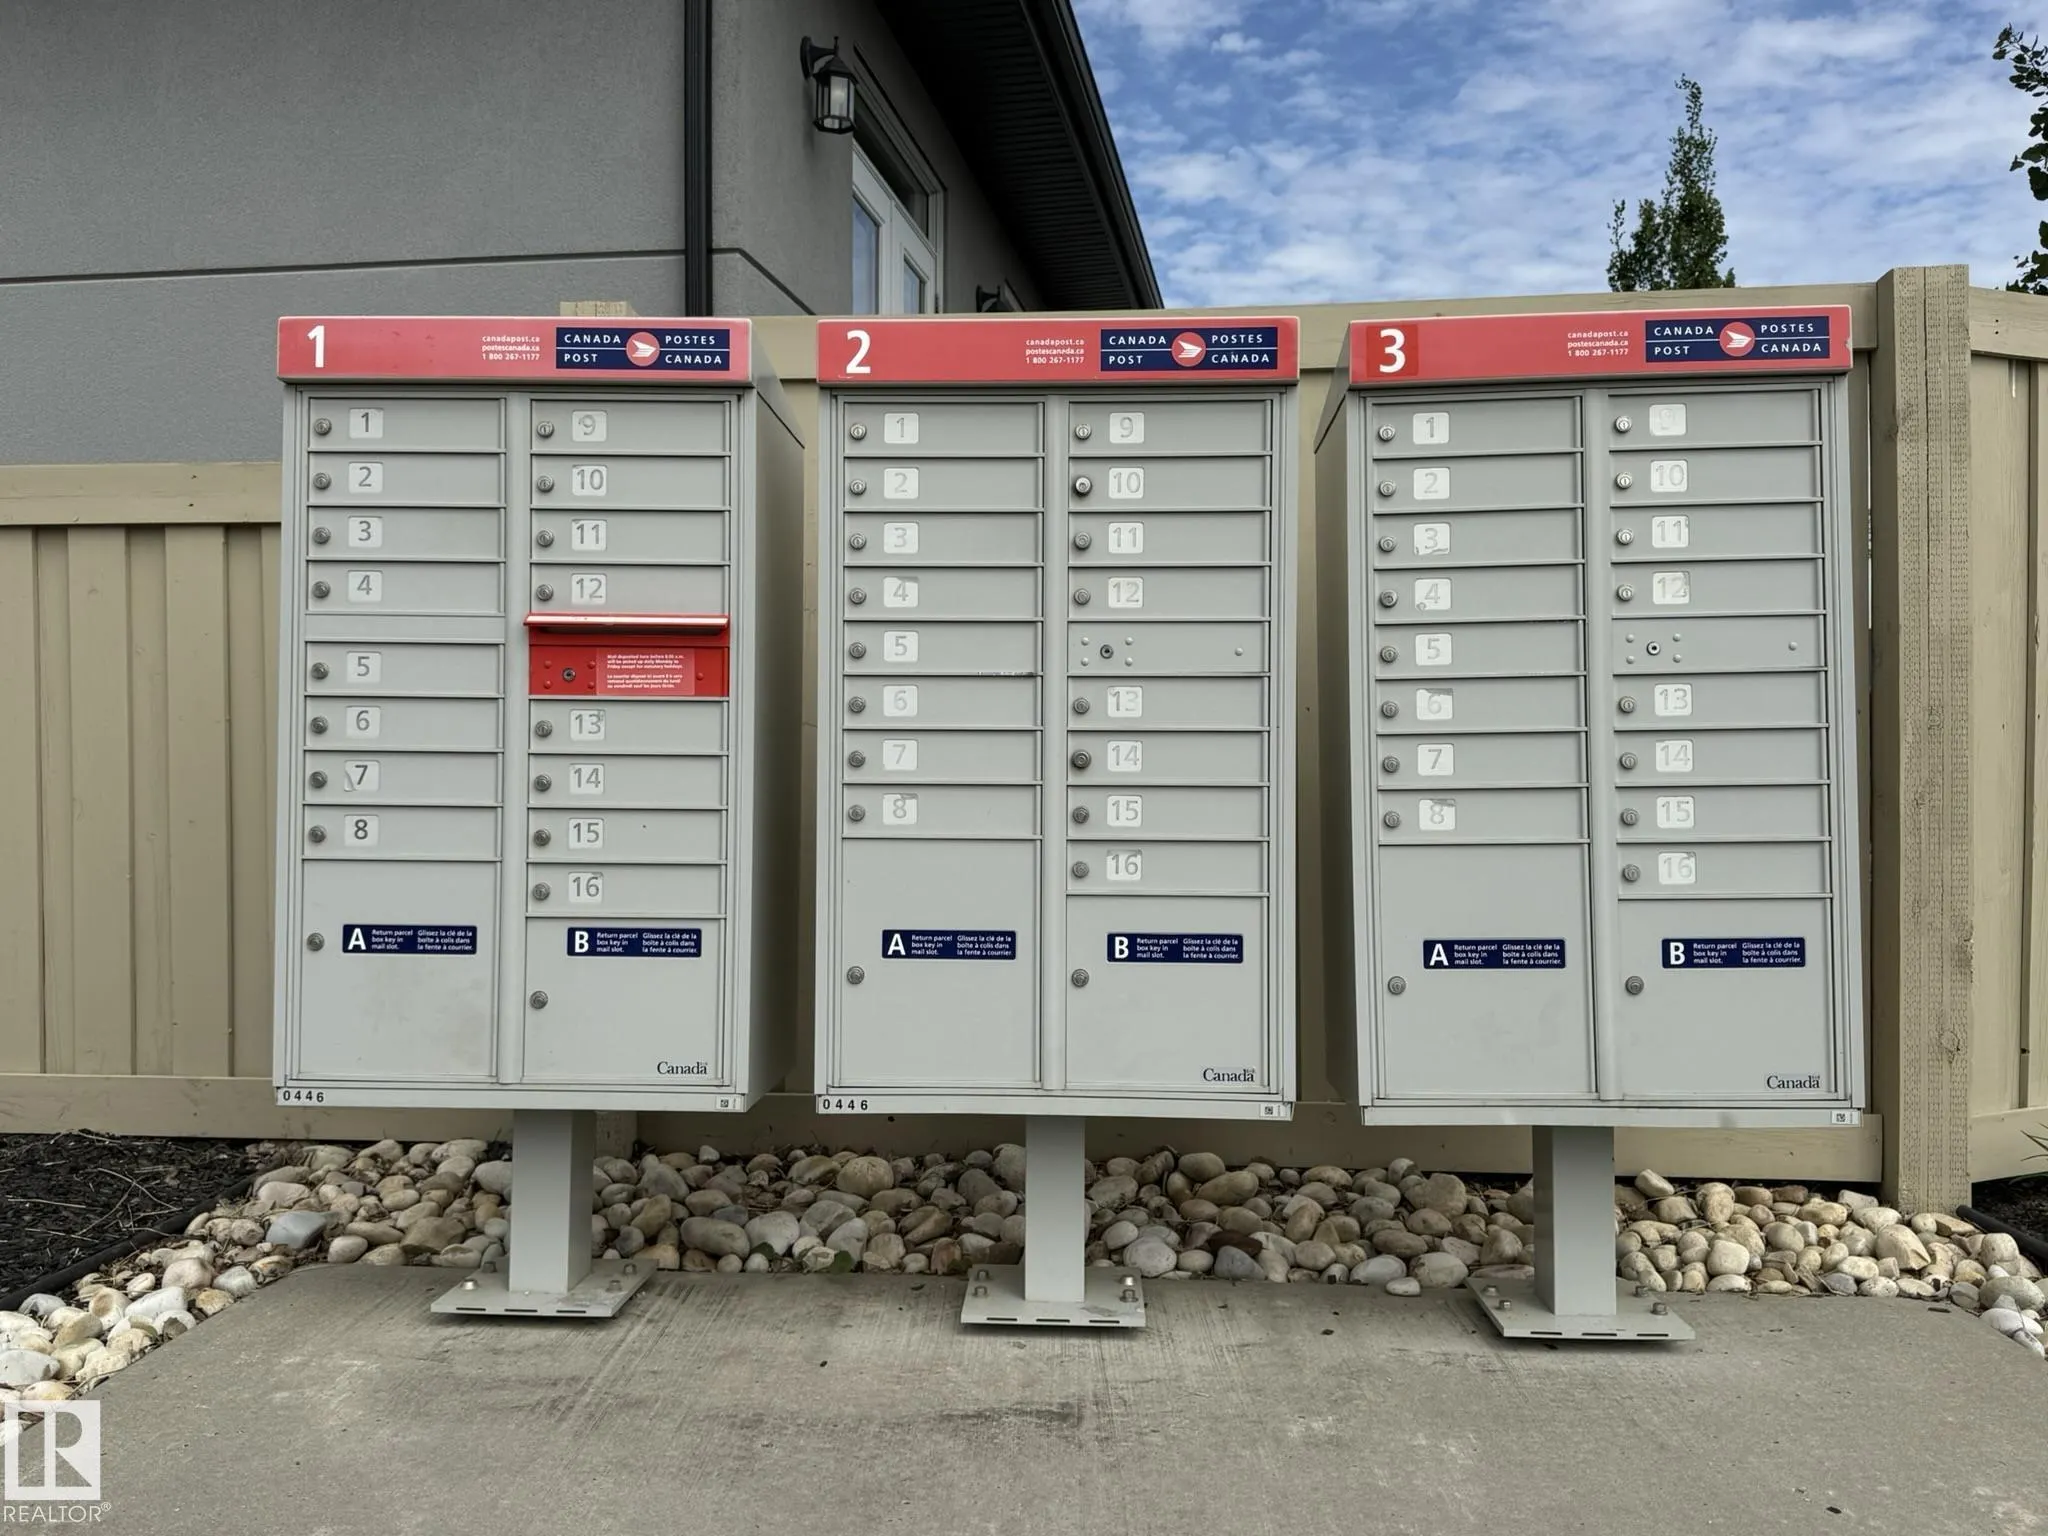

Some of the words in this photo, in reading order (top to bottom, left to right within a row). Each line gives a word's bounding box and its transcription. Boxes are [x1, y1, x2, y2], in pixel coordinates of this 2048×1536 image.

[564, 334, 621, 343] CANADA
[1212, 335, 1262, 343] POSTES
[1568, 330, 1628, 339] canadapost.ca
[1654, 326, 1714, 336] CANADA
[1761, 324, 1814, 333] POSTES
[307, 325, 325, 367] 1
[482, 344, 540, 352] postescanada.ca
[665, 335, 715, 344] POSTES
[1109, 336, 1166, 345] CANADA
[1568, 340, 1628, 348] postescanada.ca
[1761, 343, 1821, 353] CANADA
[564, 354, 598, 362] POST
[665, 355, 722, 364] CANADA
[846, 330, 871, 374] 2
[1109, 356, 1143, 364] POST
[1212, 354, 1269, 363] CANADA
[1379, 329, 1406, 372] 3
[1654, 346, 1690, 355] POST
[361, 412, 370, 433] 1
[579, 414, 596, 436] 9
[897, 417, 906, 438] 1
[1119, 417, 1134, 438] 9
[1427, 417, 1436, 438] 1
[358, 468, 372, 488] 2
[576, 468, 604, 490] 10
[894, 473, 908, 493] 2
[1114, 473, 1140, 493] 10
[1424, 472, 1439, 493] 2
[1656, 464, 1684, 487] 10
[358, 521, 372, 543] 3
[576, 523, 601, 545] 11
[894, 527, 908, 548] 3
[1113, 527, 1138, 548] 11
[1425, 528, 1439, 548] 3
[1657, 520, 1684, 542] 11
[357, 574, 373, 595] 4
[575, 578, 603, 599] 12
[893, 582, 908, 602] 4
[1113, 582, 1140, 603] 12
[1425, 583, 1441, 604] 4
[894, 636, 908, 656] 5
[1427, 639, 1441, 659] 5
[356, 656, 371, 677] 5
[893, 690, 908, 711] 6
[1112, 690, 1138, 712] 13
[1660, 688, 1687, 711] 13
[356, 711, 370, 731] 6
[574, 713, 601, 735] 13
[893, 744, 907, 764] 7
[1112, 745, 1139, 766] 14
[1428, 749, 1443, 770] 7
[1660, 744, 1691, 767] 14
[355, 765, 368, 785] 7
[574, 768, 600, 789] 14
[893, 798, 907, 819] 8
[1112, 799, 1138, 821] 15
[1430, 804, 1445, 824] 8
[1662, 801, 1690, 823] 15
[354, 820, 368, 840] 8
[573, 822, 599, 844] 15
[1111, 854, 1138, 875] 16
[1664, 857, 1693, 878] 16
[572, 877, 599, 897] 16
[348, 928, 366, 950] A
[575, 931, 588, 953] B
[887, 933, 906, 955] A
[1115, 937, 1128, 958] B
[1429, 943, 1449, 966] A
[1670, 942, 1685, 965] B
[657, 1061, 707, 1075] Canada
[1203, 1068, 1254, 1082] Canada
[1767, 1075, 1820, 1090] Canada
[282, 1090, 324, 1103] 0446
[822, 1099, 868, 1110] 0446
